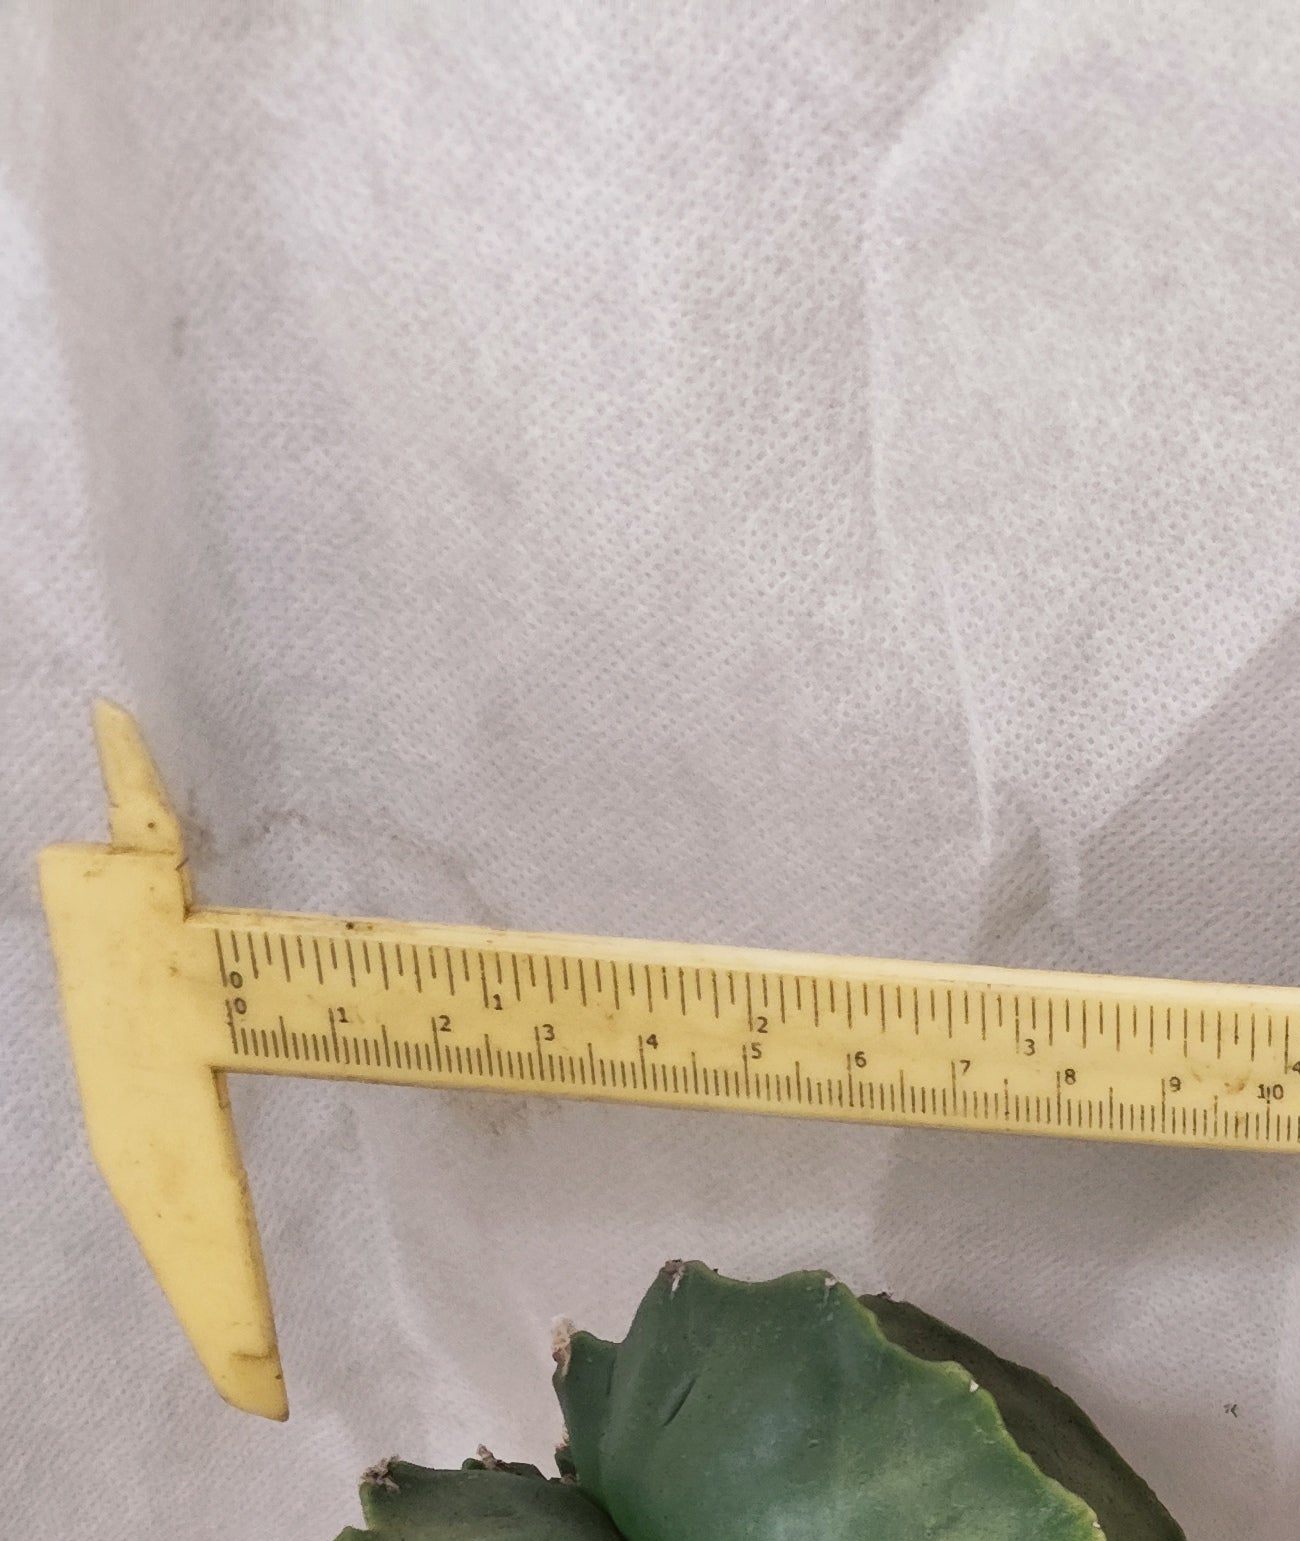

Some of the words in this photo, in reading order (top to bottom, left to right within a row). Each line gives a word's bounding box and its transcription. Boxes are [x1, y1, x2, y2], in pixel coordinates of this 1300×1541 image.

[229, 972, 242, 989] 0
[493, 994, 502, 1010] 1
[757, 1016, 769, 1033] 2
[1023, 1039, 1036, 1056] 3
[234, 996, 246, 1014] 0
[337, 1007, 348, 1023] 1
[439, 1015, 451, 1032] 2
[542, 1025, 555, 1041] 3
[645, 1034, 659, 1049] 4
[750, 1043, 763, 1059] 5
[854, 1051, 867, 1068] 6
[959, 1060, 970, 1075] 7
[1064, 1069, 1076, 1085] 8
[1169, 1077, 1181, 1093] 9
[1258, 1085, 1284, 1100] 10
